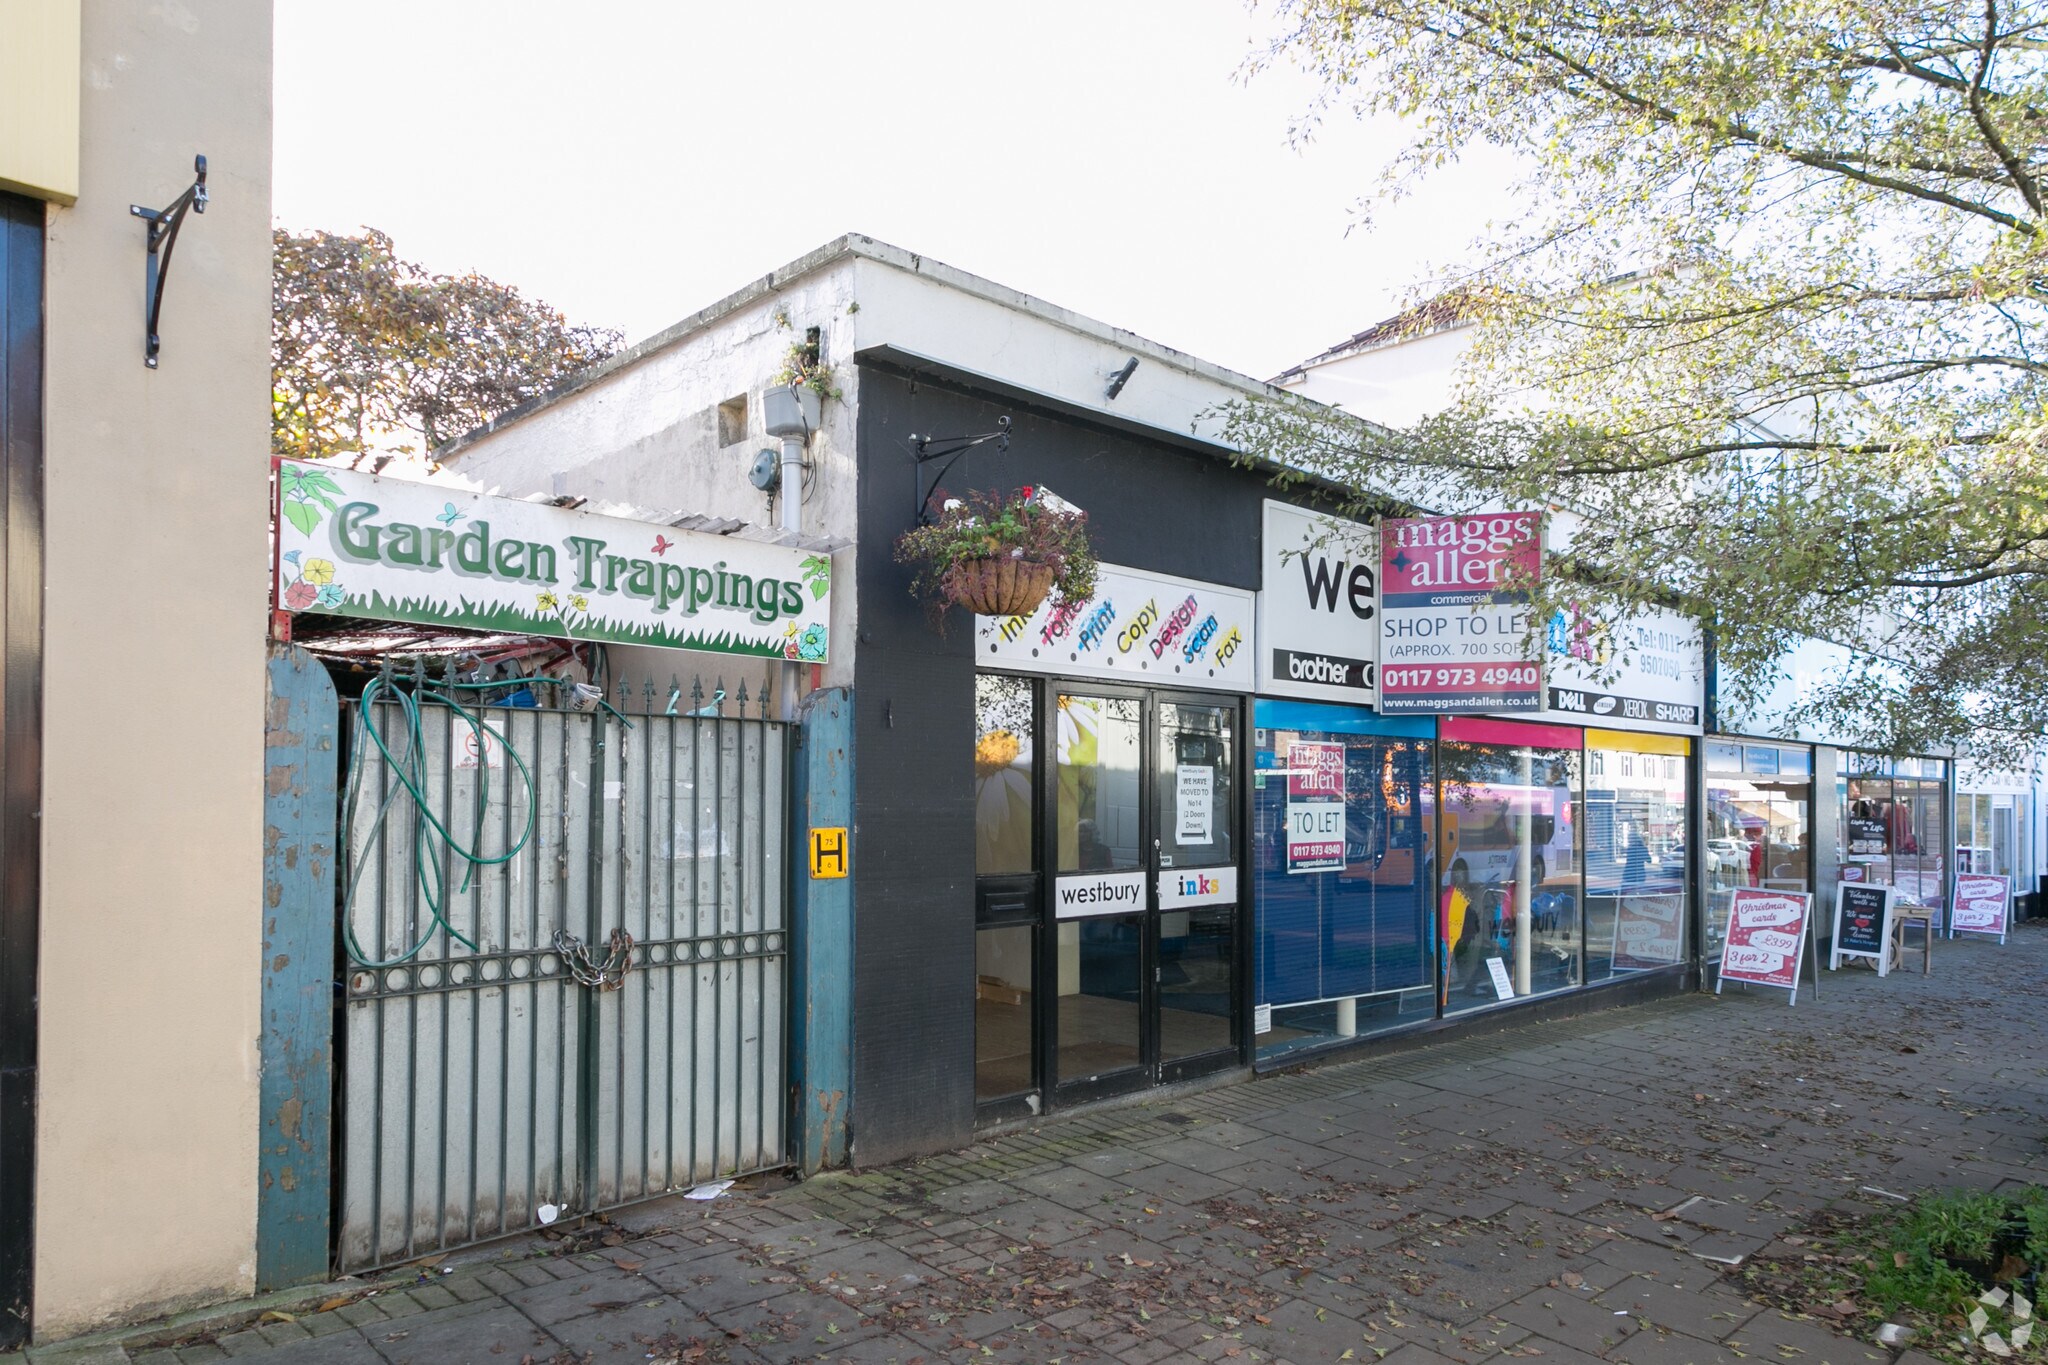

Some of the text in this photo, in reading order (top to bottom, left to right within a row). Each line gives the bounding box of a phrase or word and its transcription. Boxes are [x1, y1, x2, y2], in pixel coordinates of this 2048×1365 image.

[1395, 516, 1533, 555] maggs
[332, 501, 804, 622] Garden Trappings
[1078, 600, 1116, 652] Print
[1117, 598, 1158, 654] Copy
[1148, 594, 1198, 661] Design
[1384, 615, 1529, 638] SHOP TO LE
[1182, 614, 1219, 664] Scan
[1215, 630, 1242, 668] Fax
[1389, 641, 1535, 658] (APPROX. 700 SQF)
[1637, 626, 1680, 653] Tel: 0117
[1289, 653, 1349, 684] brother
[1385, 669, 1432, 687] 0117
[1436, 668, 1476, 686] 973
[1481, 667, 1537, 685] 4940
[1384, 696, 1538, 709] www.maggsandallen.co.uk
[1558, 690, 1587, 712] DELL
[1623, 699, 1650, 719] XEROX
[1655, 704, 1695, 722] SHARP
[1183, 777, 1207, 785] WE HAVE
[1293, 812, 1340, 834] TO LET
[816, 832, 843, 873] H
[825, 838, 834, 846] 75
[1293, 844, 1341, 857] 0117 973 4940
[1061, 881, 1141, 905] westbury
[1178, 874, 1219, 896] inks
[1962, 882, 1993, 890] Christmas
[1740, 902, 1787, 914] Christmas
[1752, 912, 1777, 922] cards
[1964, 914, 1977, 922] for
[1979, 913, 1985, 921] 2
[1729, 951, 1770, 965] 3 for 2
